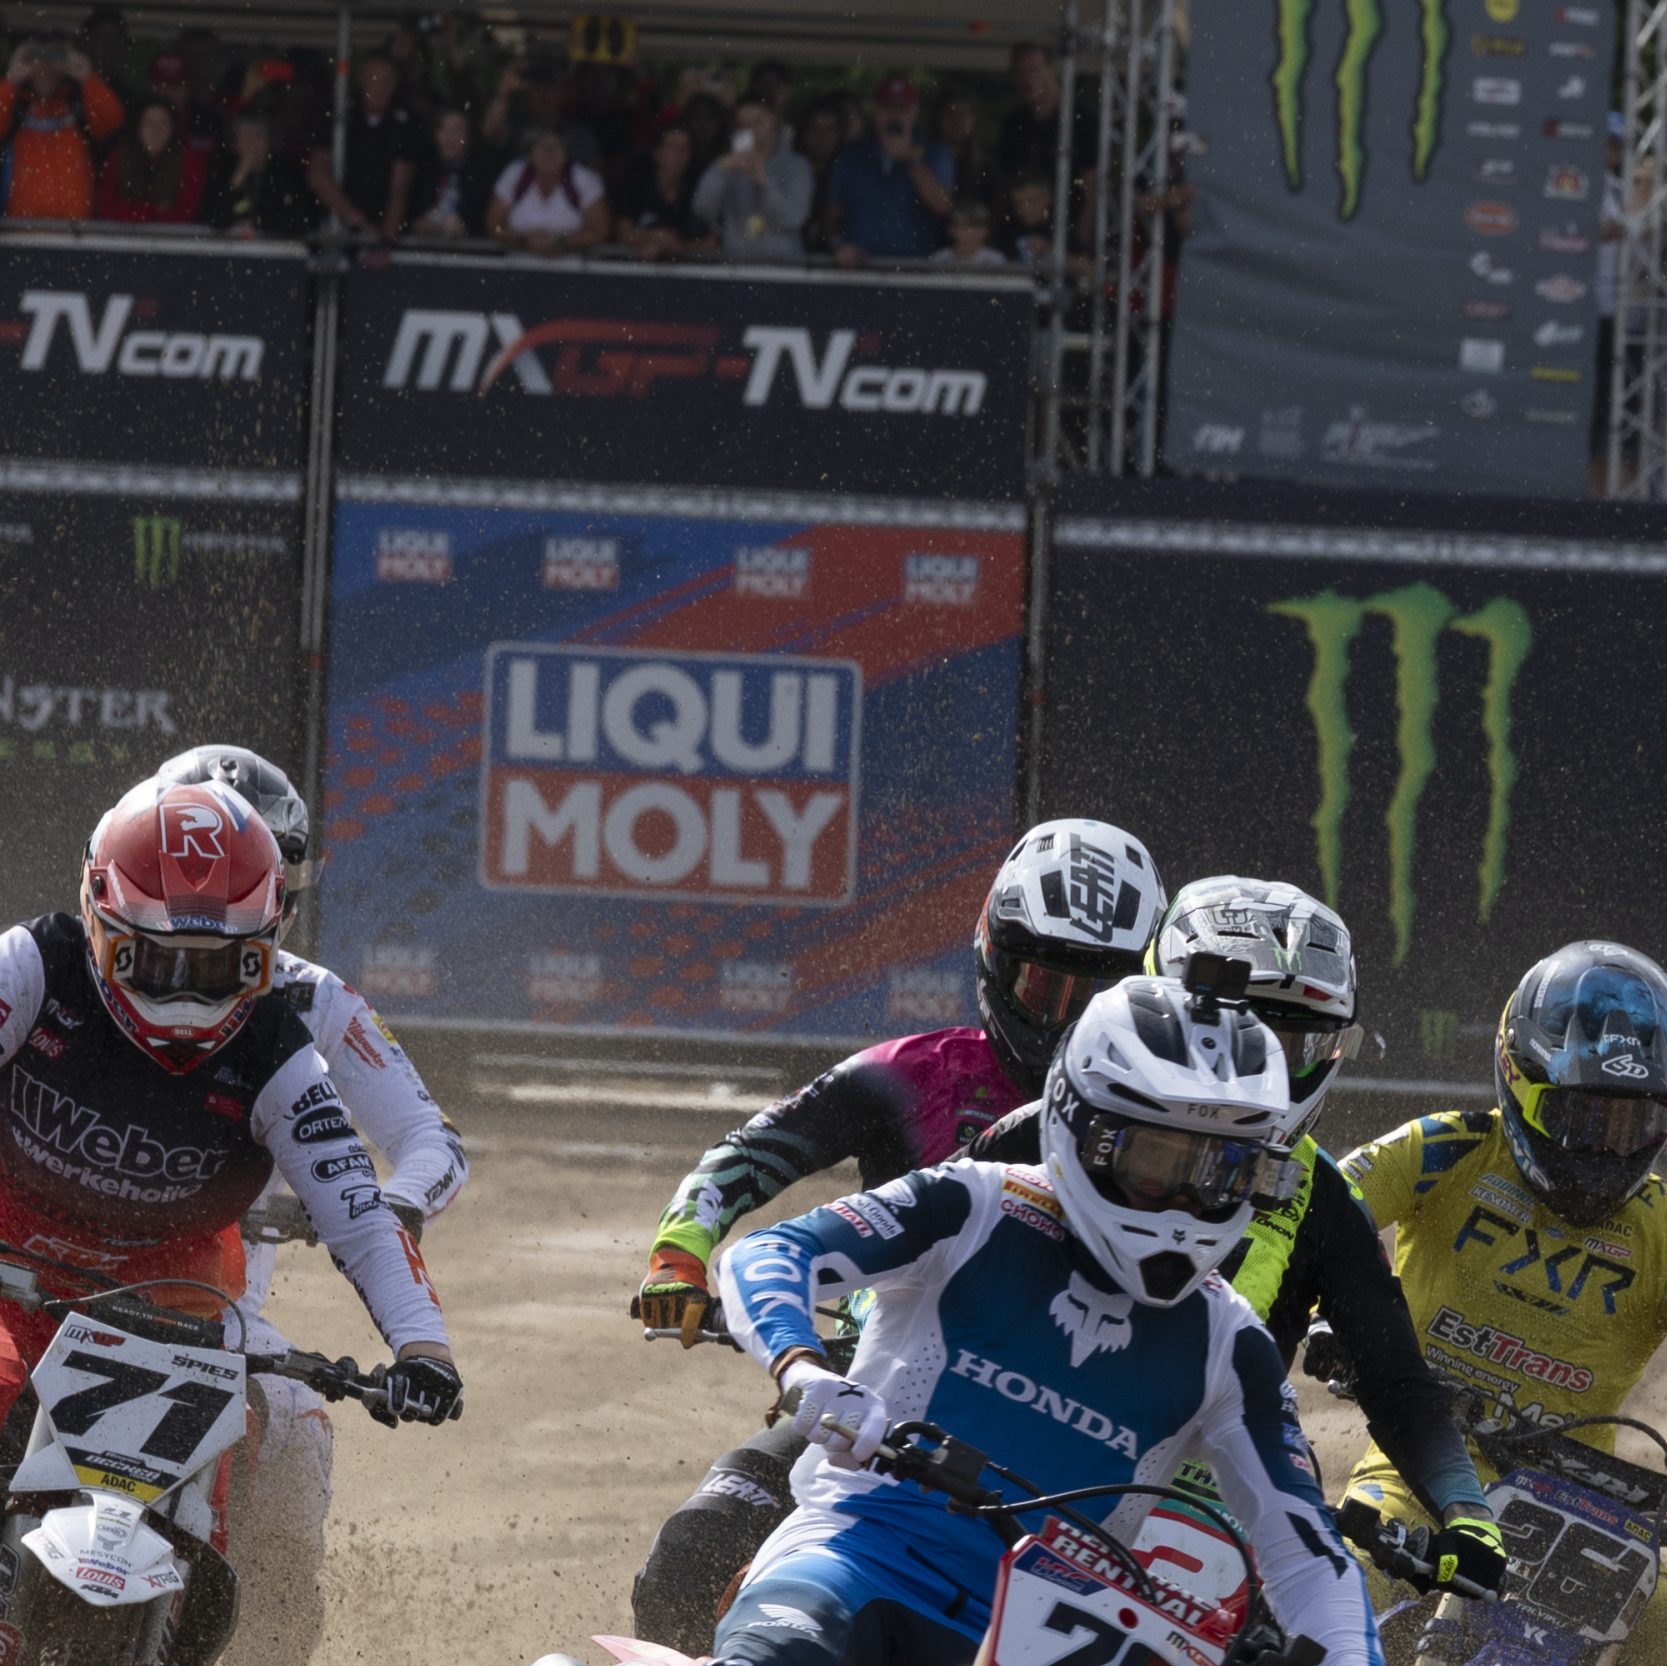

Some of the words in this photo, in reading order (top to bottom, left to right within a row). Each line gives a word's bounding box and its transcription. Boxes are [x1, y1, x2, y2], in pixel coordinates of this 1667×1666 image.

[507, 660, 838, 775] LIQUI
[504, 778, 843, 889] MOLY
[291, 1081, 338, 1116] BELL
[1188, 1104, 1220, 1120] FOX
[1094, 1129, 1116, 1167] FOX
[1001, 1199, 1067, 1243] CHOHO
[1453, 1206, 1637, 1316] FXR
[111, 1305, 138, 1318] READY
[176, 1320, 200, 1331] RACE
[171, 1354, 239, 1381] SPIES
[1426, 1304, 1595, 1393] EstTrans
[1426, 1343, 1475, 1377] Winning
[1474, 1369, 1521, 1393] energy
[49, 1350, 235, 1466] 71
[950, 1347, 1140, 1462] HONDA
[100, 1474, 136, 1493] ADAC
[80, 1548, 134, 1568] MESYCON
